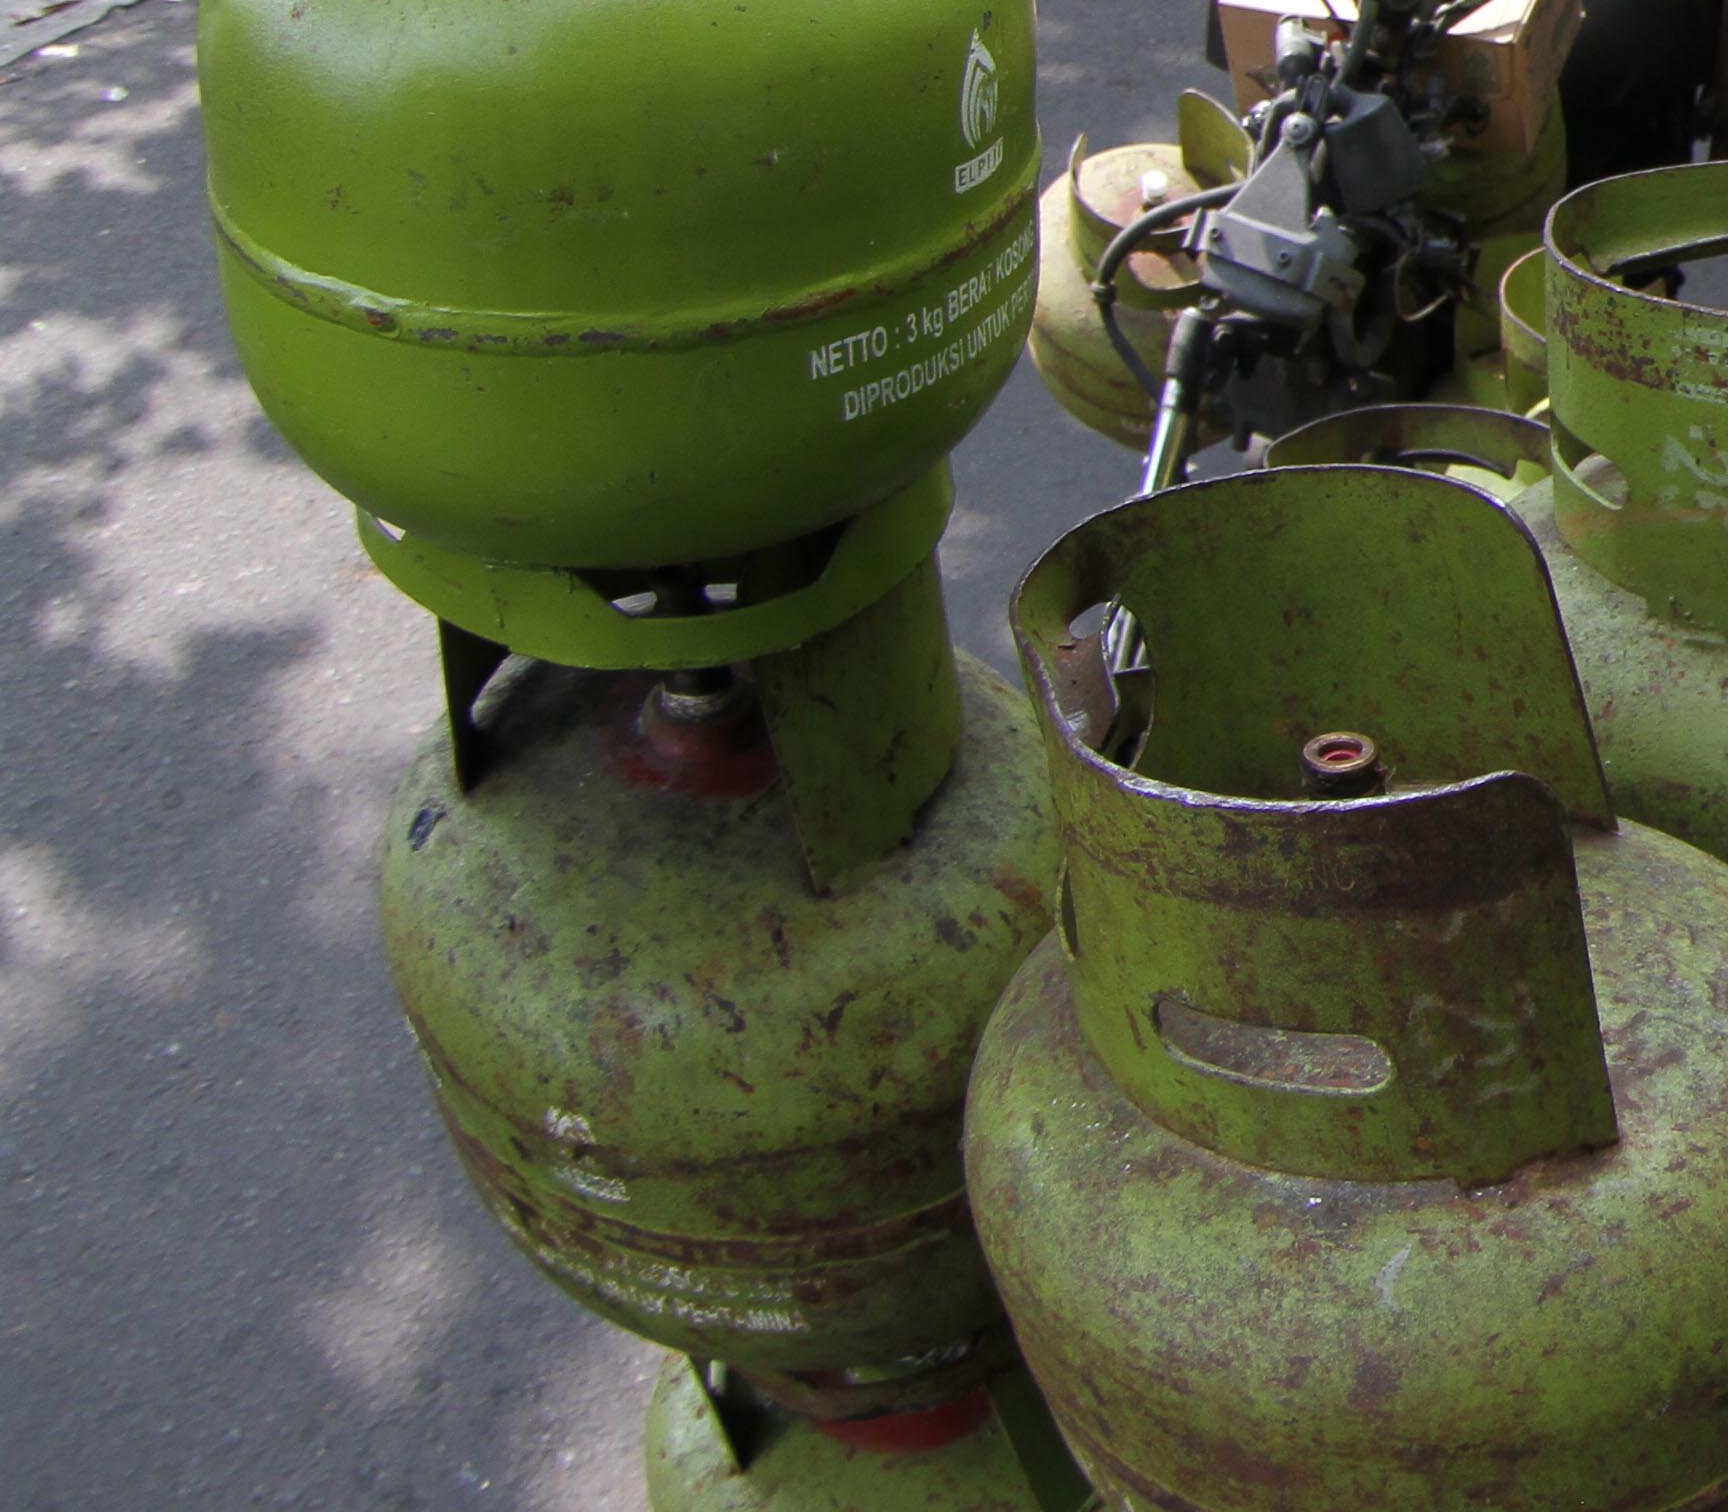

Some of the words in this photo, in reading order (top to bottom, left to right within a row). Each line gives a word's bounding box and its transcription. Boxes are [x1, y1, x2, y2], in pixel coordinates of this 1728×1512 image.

[809, 325, 888, 380] NETTO
[906, 314, 919, 344] 3
[923, 307, 944, 337] kg
[947, 265, 993, 324] BERAT
[843, 336, 965, 421] DIPRODUKSI
[966, 301, 1011, 361] UNTUK
